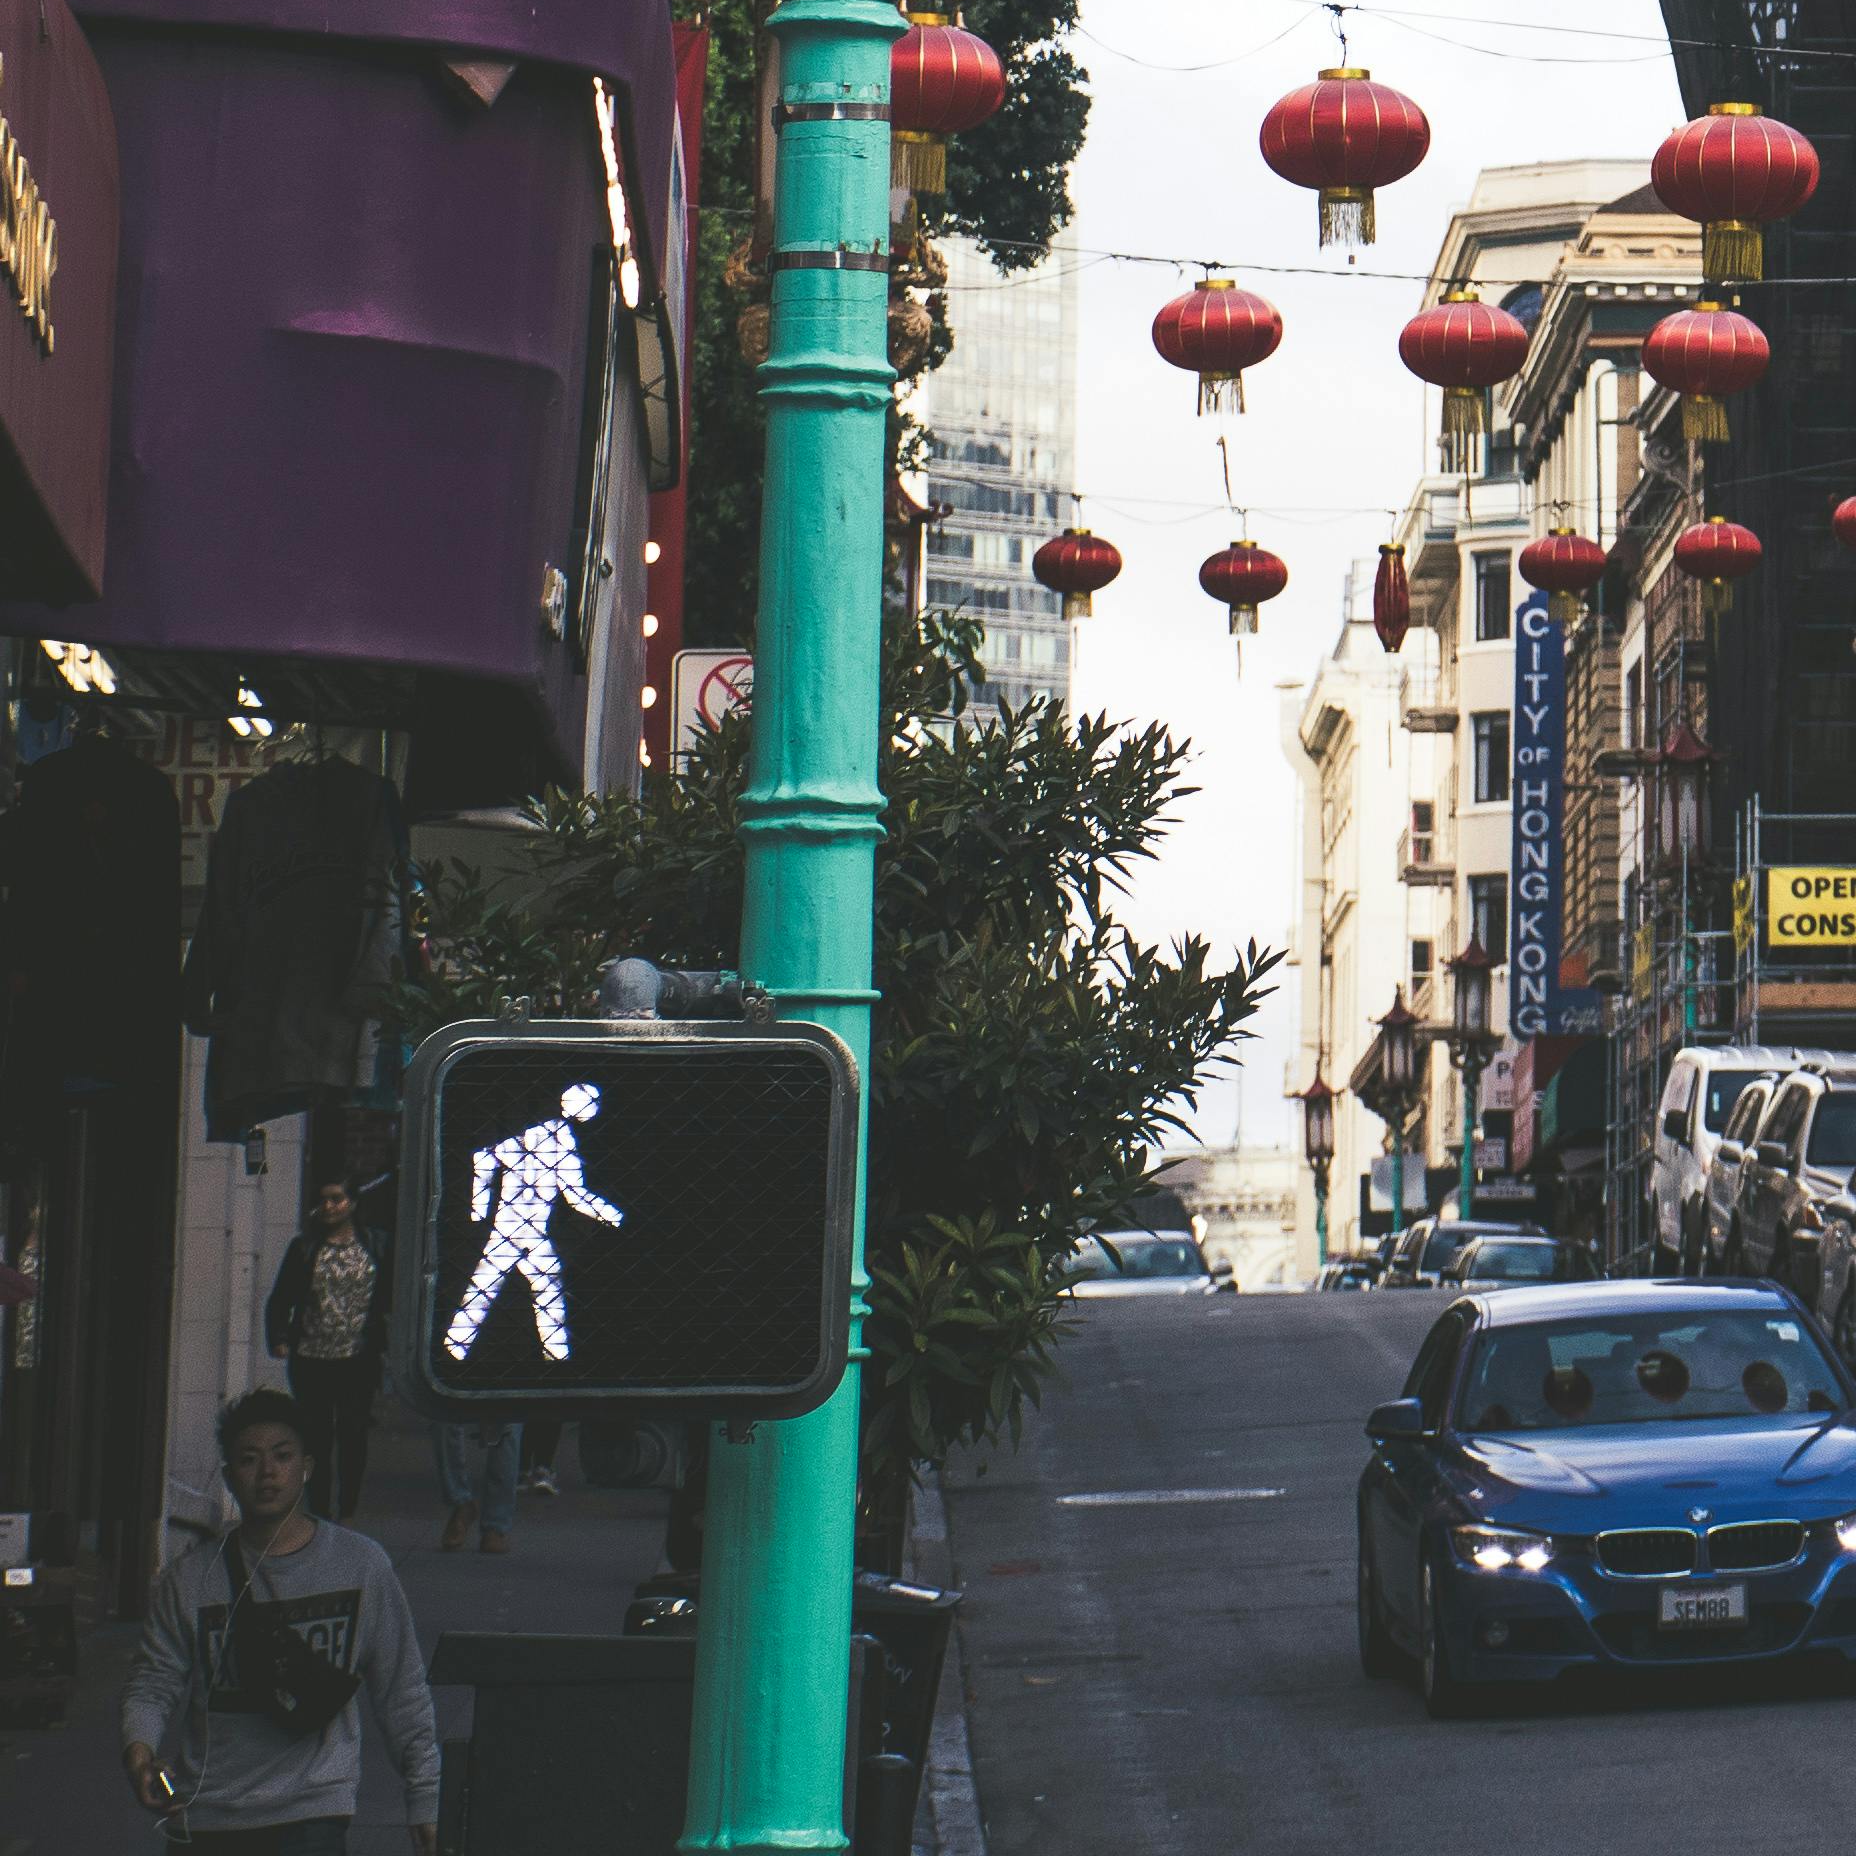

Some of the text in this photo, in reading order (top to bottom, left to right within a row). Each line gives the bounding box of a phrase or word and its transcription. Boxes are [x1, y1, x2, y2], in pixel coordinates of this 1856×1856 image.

[1521, 606, 1551, 737] CITY
[1518, 746, 1551, 766] OF
[1517, 780, 1549, 902] HONG
[1515, 912, 1549, 1034] KONG
